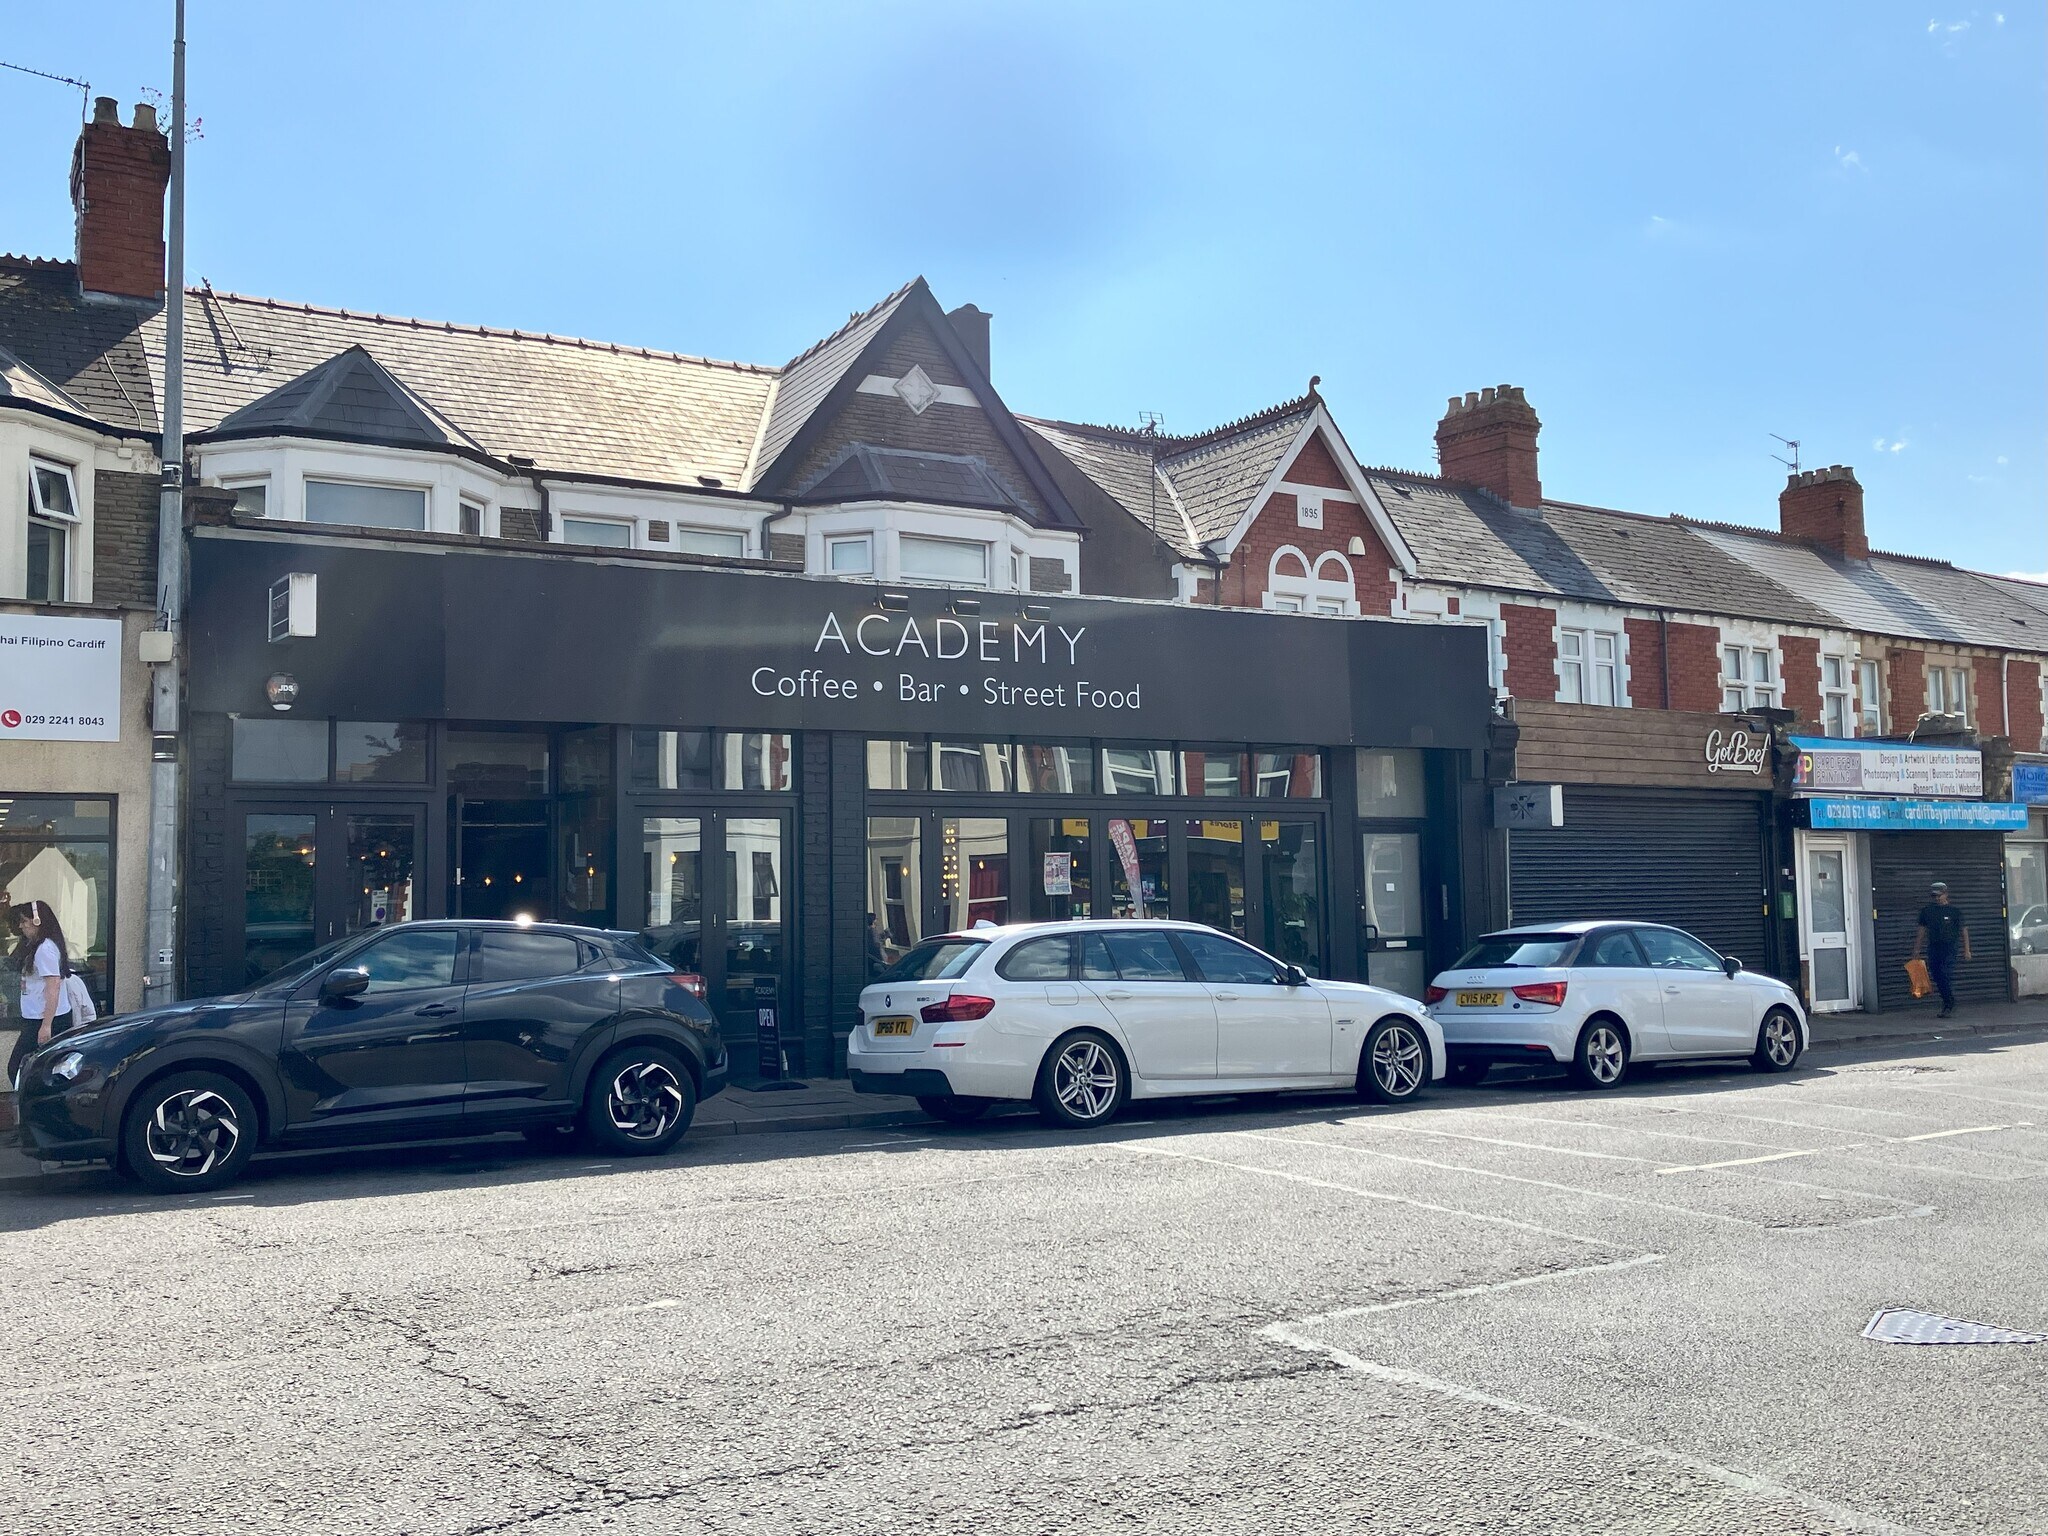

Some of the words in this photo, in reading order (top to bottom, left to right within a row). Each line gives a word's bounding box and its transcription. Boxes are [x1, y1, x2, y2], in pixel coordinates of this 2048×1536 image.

[1301, 506, 1318, 519] 1895
[21, 636, 64, 648] Filipino
[67, 638, 106, 649] Cardiff
[814, 611, 1086, 665] ACADEMY
[751, 666, 858, 699] Coffee
[899, 673, 945, 702] Bar
[983, 677, 1066, 707] Street
[1077, 681, 1140, 709] Food
[25, 715, 45, 724] 029
[48, 716, 74, 725] 2241
[78, 716, 105, 726] 8043
[1880, 754, 1898, 766] Design
[1904, 754, 1925, 764] Artwork
[1929, 755, 1950, 764] Leaflets
[1956, 754, 1980, 765] Brochures
[1816, 770, 1851, 784] PRINTING
[1864, 769, 1900, 781] Photocopying
[1906, 769, 1928, 781] Scanning
[1932, 769, 1954, 779] Business
[1955, 769, 1981, 781] Stationery
[1940, 784, 1955, 794] Vinyls
[1959, 784, 1981, 793] Websites
[1827, 804, 1850, 818] 02920
[1852, 805, 1865, 819] 621
[1460, 994, 1478, 1004] CV15
[1480, 993, 1498, 1004] HPZ
[758, 1008, 775, 1027] OPEN
